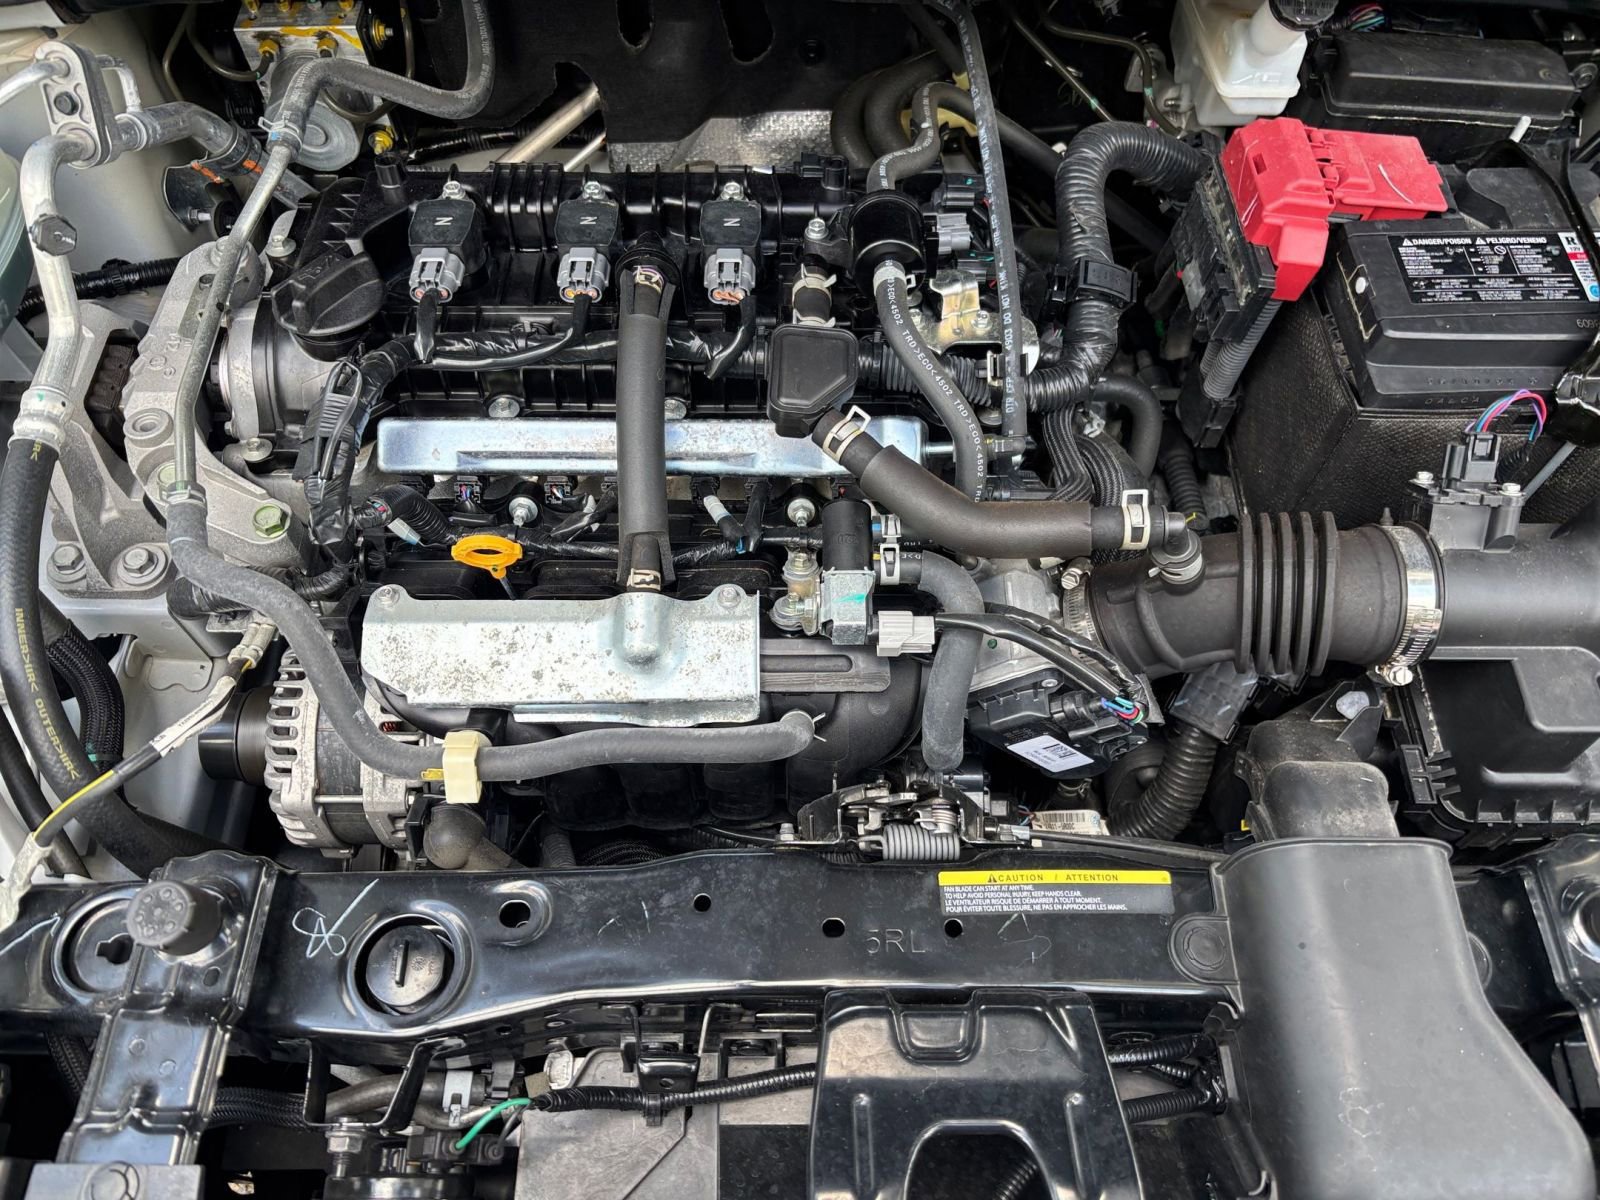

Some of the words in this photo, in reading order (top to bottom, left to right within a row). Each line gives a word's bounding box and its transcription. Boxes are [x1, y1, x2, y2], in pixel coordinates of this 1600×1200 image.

[1412, 238, 1472, 246] DANGER/POISON
[1485, 237, 1547, 245] PELIGRO/VENENO
[999, 271, 1008, 291] KINK
[1001, 294, 1011, 309] NOT
[1003, 312, 1012, 326] DO
[1004, 328, 1014, 351] 4903
[1006, 378, 1015, 397] CFP
[1005, 397, 1015, 414] DTR
[998, 874, 1044, 882] CAUTION
[1065, 874, 1119, 882] ATTENTION
[866, 928, 926, 954] 5RL
